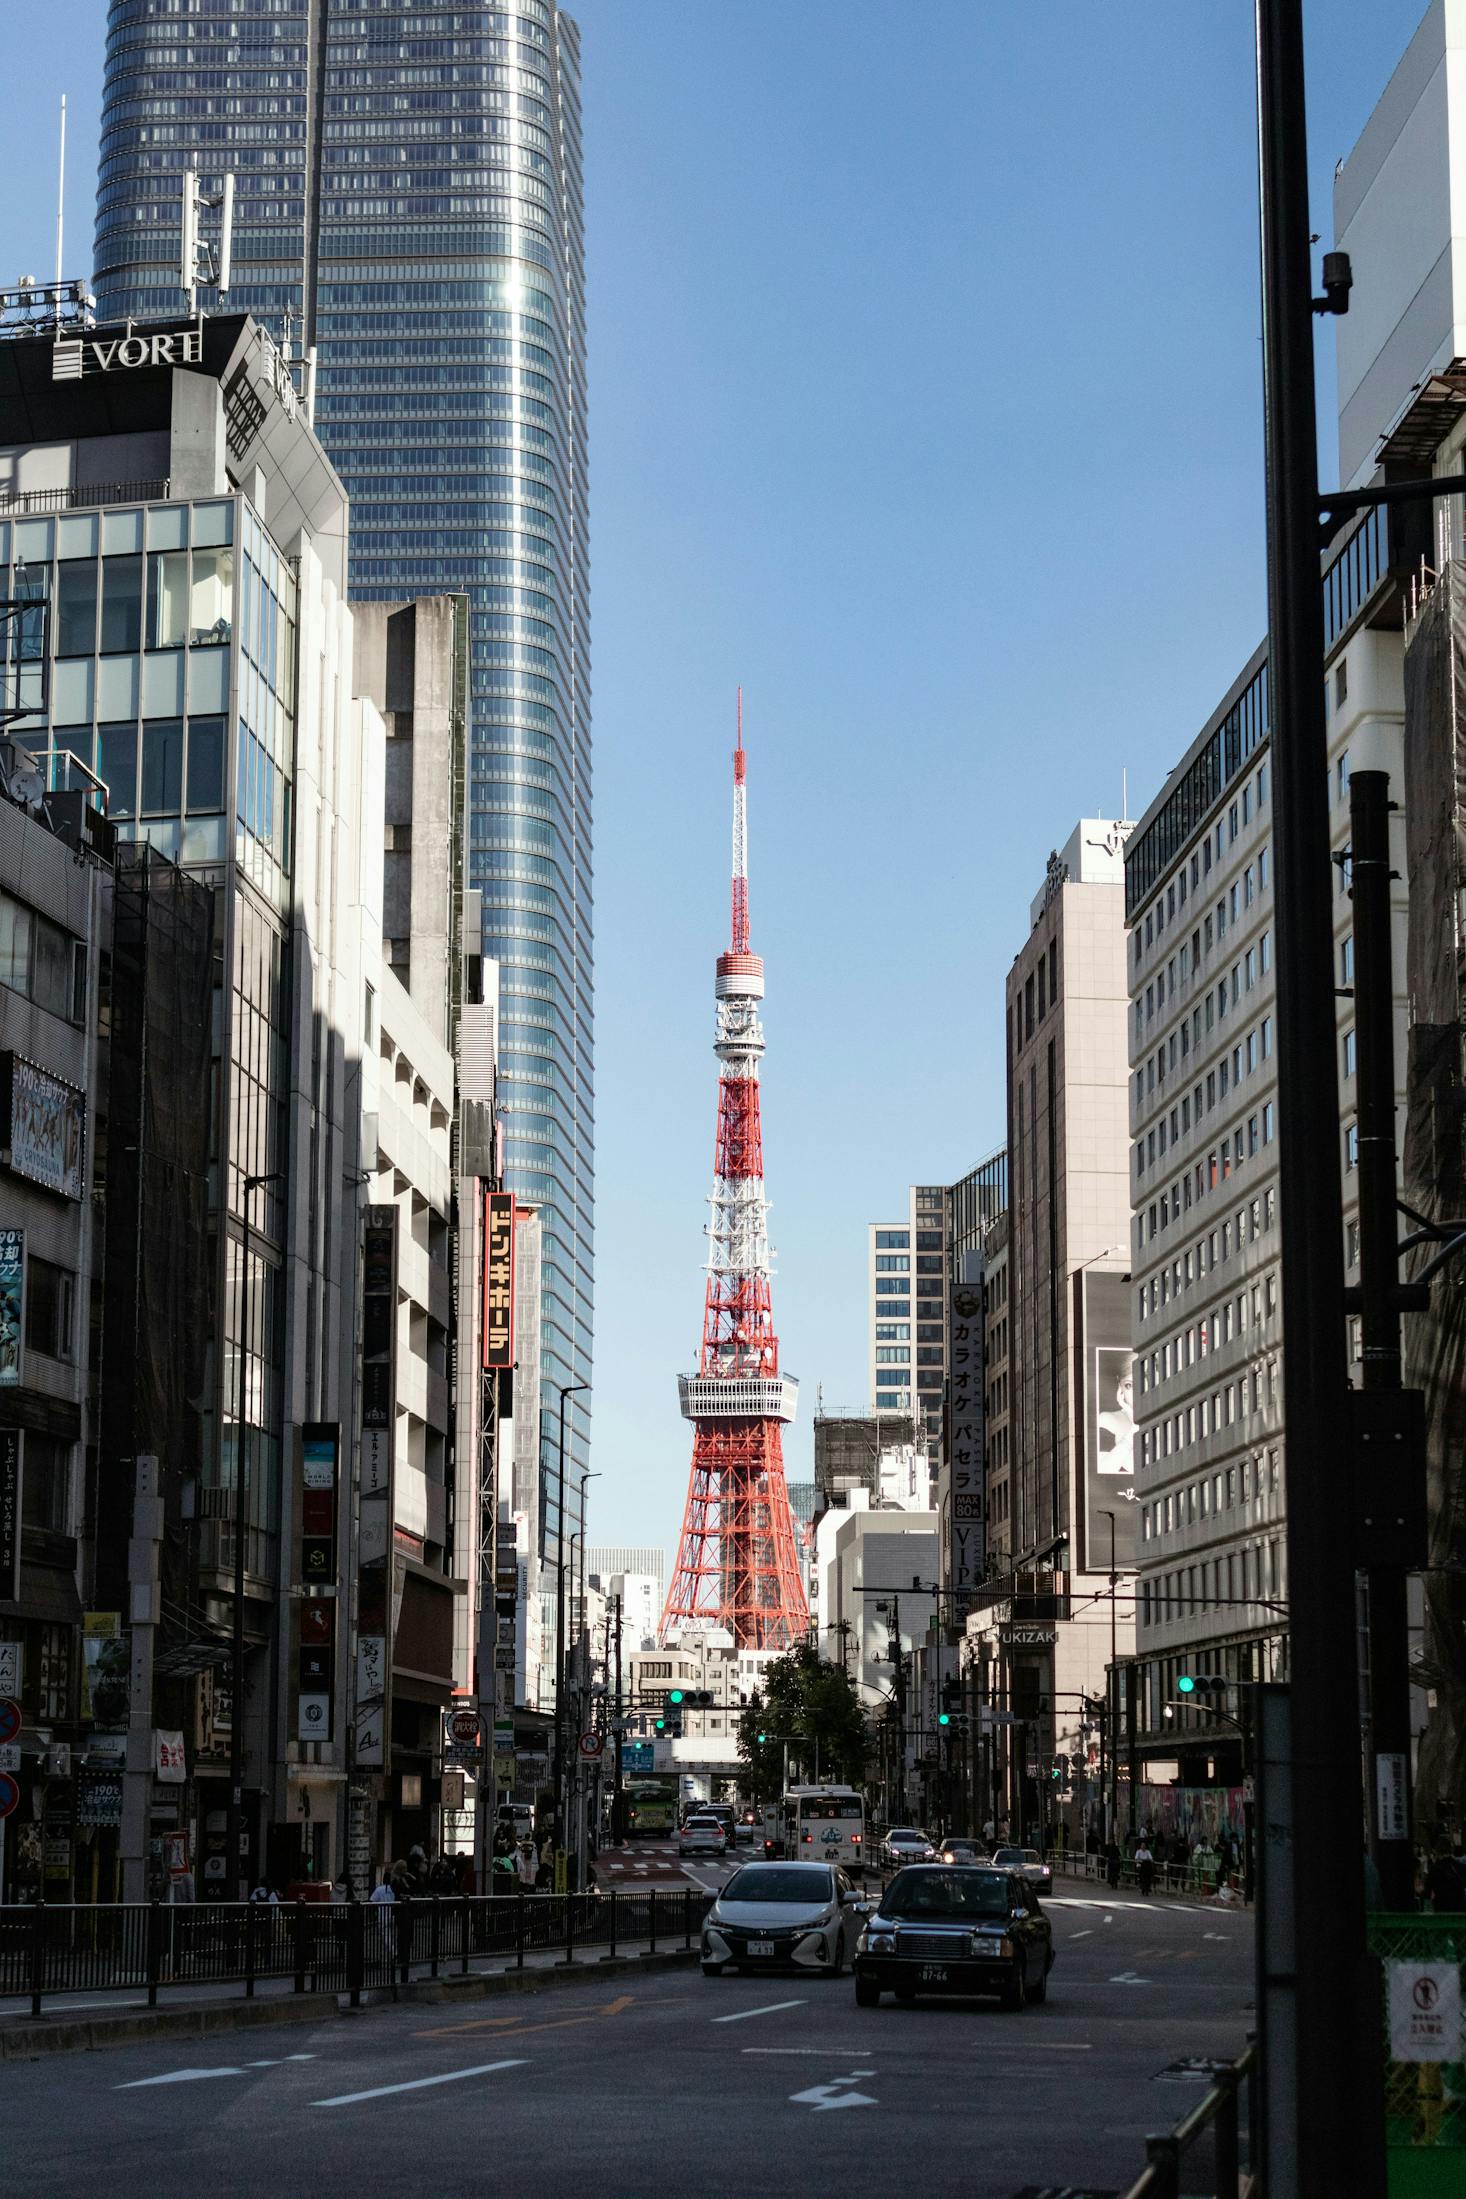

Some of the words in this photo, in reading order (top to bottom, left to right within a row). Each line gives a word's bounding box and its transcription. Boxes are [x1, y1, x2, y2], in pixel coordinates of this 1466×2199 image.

[91, 331, 202, 371] VORT
[490, 1210, 511, 1350] ドン・キホーテ
[955, 1324, 971, 1412] カラオケ
[955, 1424, 972, 1488] パセラ
[957, 1496, 979, 1505] MAX
[996, 1632, 1060, 1644] YUKIZAKI
